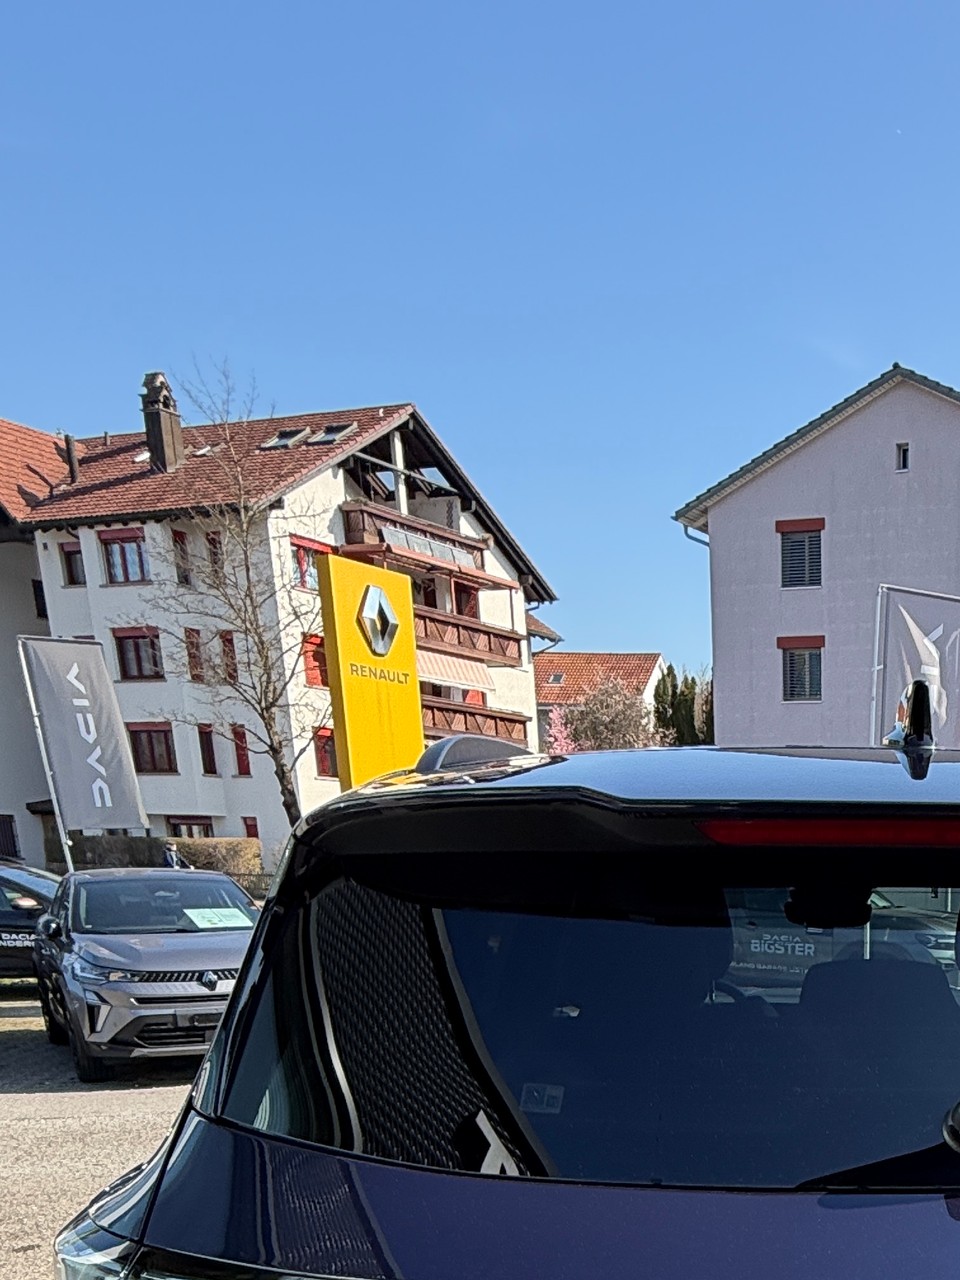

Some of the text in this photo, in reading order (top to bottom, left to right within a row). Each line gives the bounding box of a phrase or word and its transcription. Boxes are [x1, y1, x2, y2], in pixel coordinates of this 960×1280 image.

[349, 662, 410, 685] RENAULT
[66, 662, 112, 807] DACIA
[750, 940, 815, 956] BIGSTER
